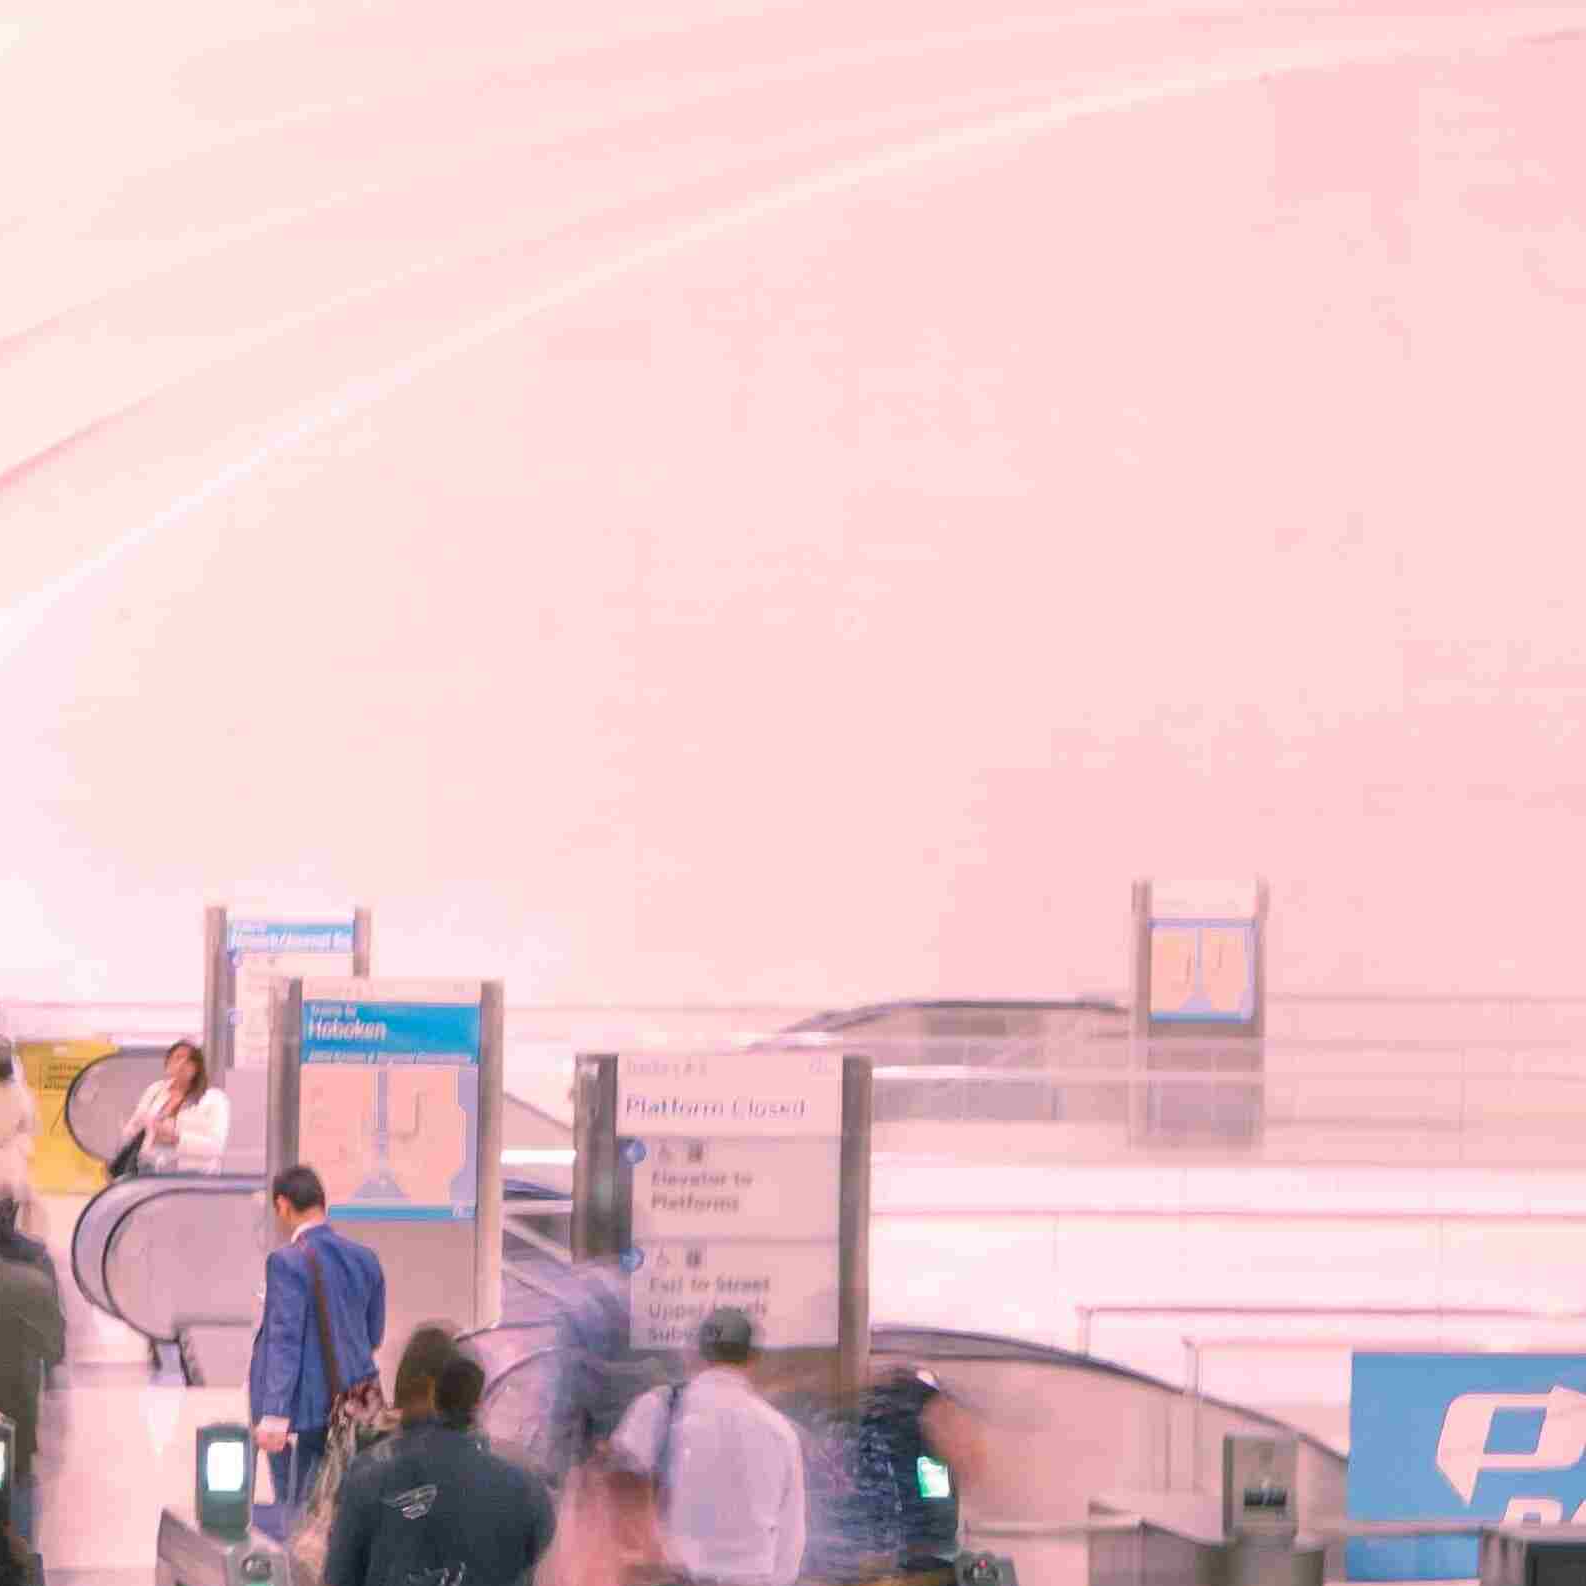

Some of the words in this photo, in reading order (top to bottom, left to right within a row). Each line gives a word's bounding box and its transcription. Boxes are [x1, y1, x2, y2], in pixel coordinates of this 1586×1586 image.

[309, 1018, 387, 1040] Hoboken
[626, 1094, 725, 1118] Platform
[730, 1096, 807, 1118] Closed
